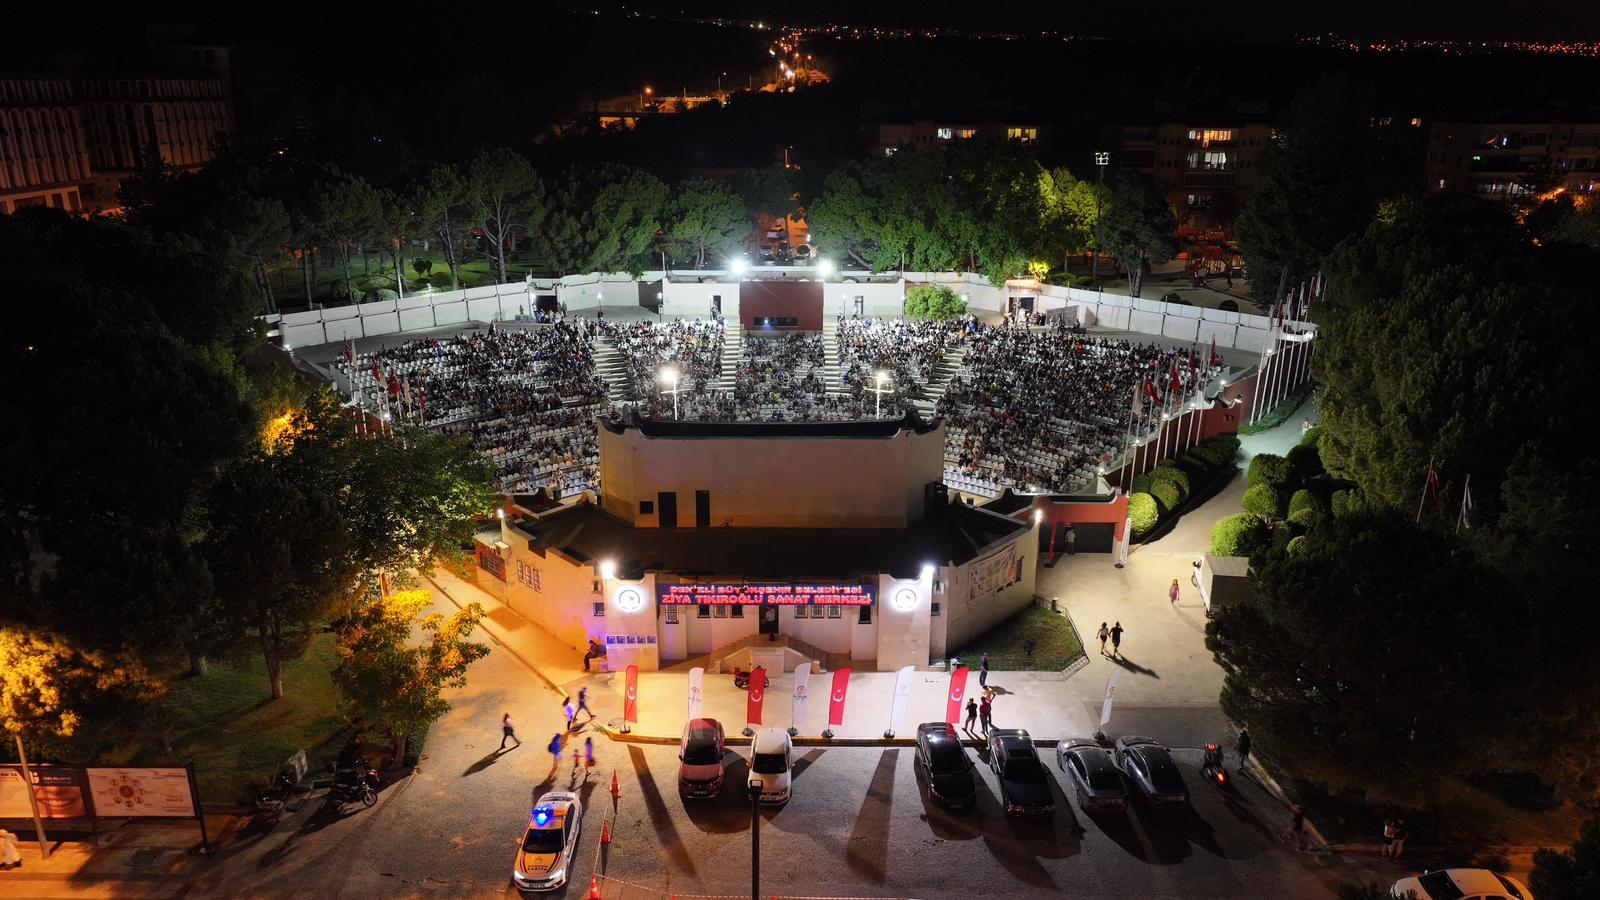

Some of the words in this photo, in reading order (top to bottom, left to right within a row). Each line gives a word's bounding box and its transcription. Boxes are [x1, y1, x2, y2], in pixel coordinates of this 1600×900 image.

[662, 593, 692, 604] ZİYA
[767, 594, 810, 604] SANAT
[814, 593, 872, 604] MERKEZİ
